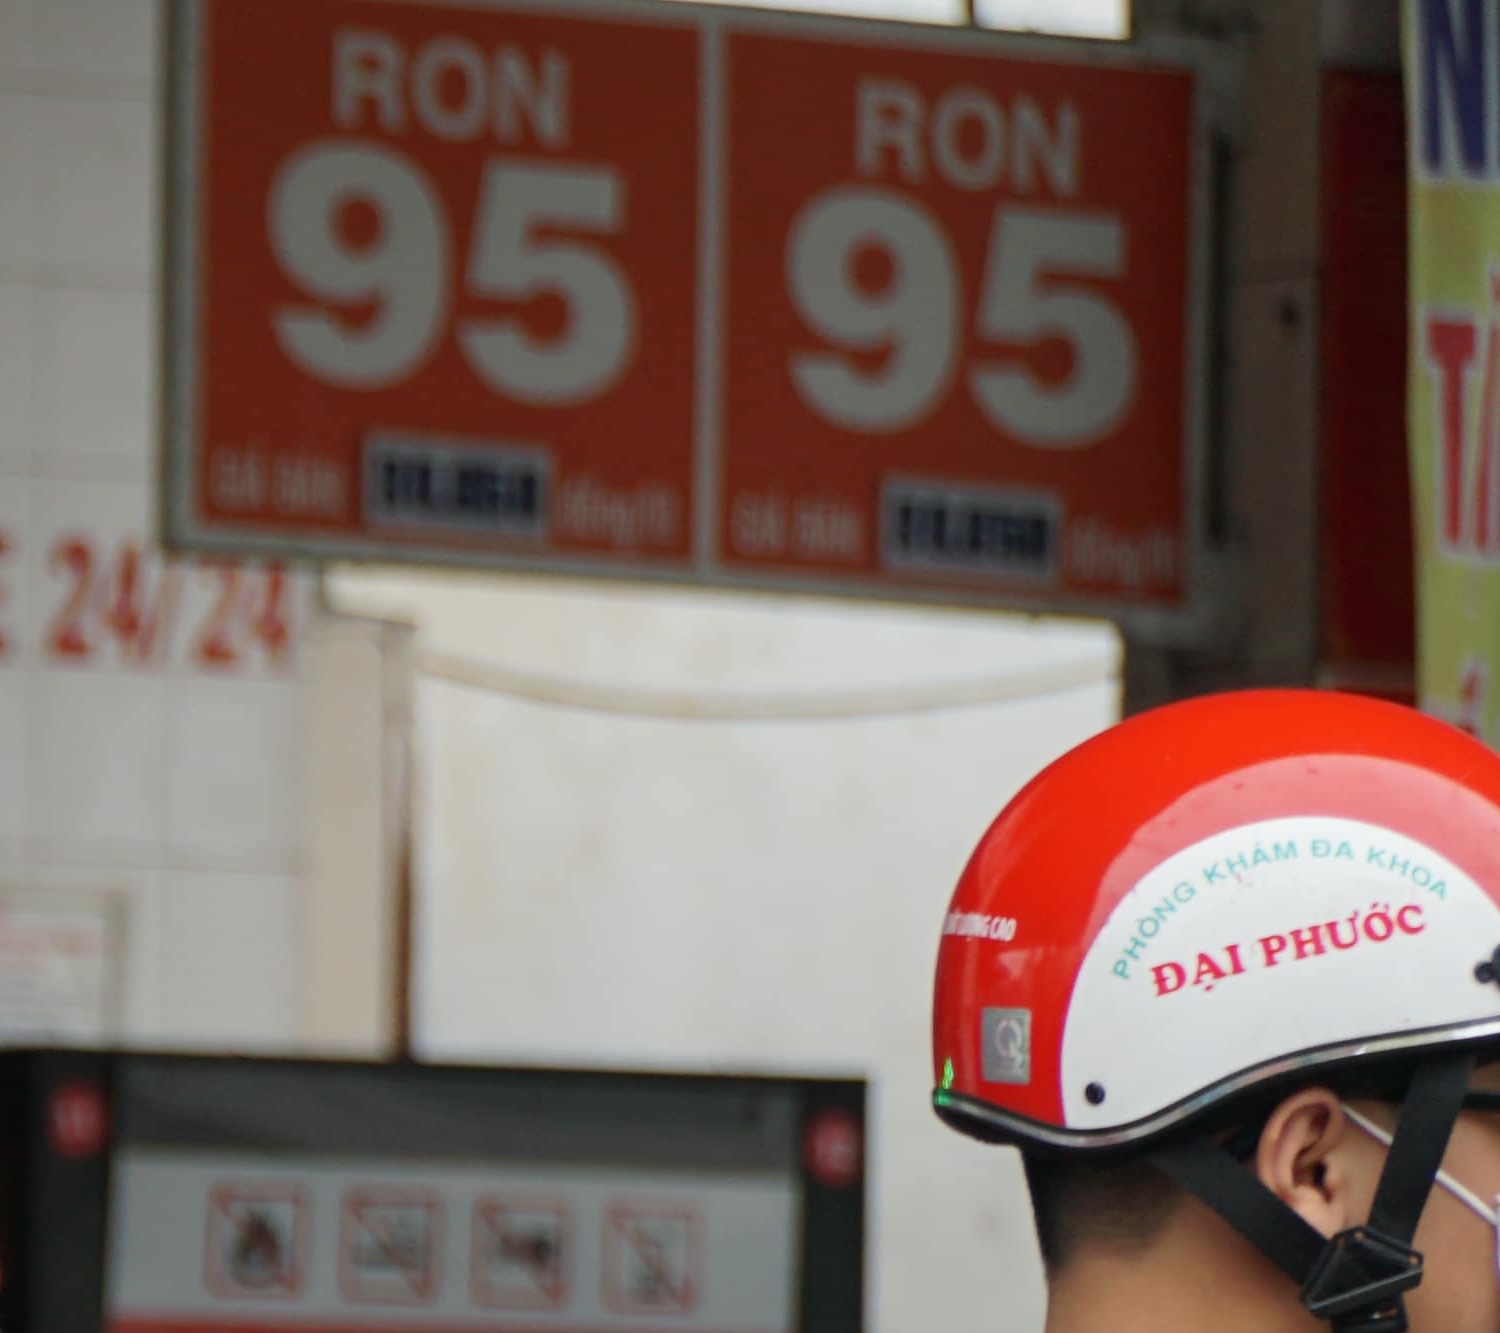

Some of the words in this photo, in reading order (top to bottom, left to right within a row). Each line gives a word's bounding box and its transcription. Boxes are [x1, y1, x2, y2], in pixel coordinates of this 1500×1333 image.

[335, 30, 568, 144] RON
[857, 79, 1081, 197] RON
[265, 144, 635, 404] 95
[784, 190, 1139, 445] 95
[49, 538, 291, 666] 24/24
[1112, 881, 1197, 980] PHÒNG
[1203, 838, 1297, 885] KHÁM
[1311, 838, 1354, 860] ĐA
[1367, 847, 1449, 901] KHOA
[1150, 944, 1247, 998] ĐẠI
[1258, 902, 1427, 968] PHƯỚC
